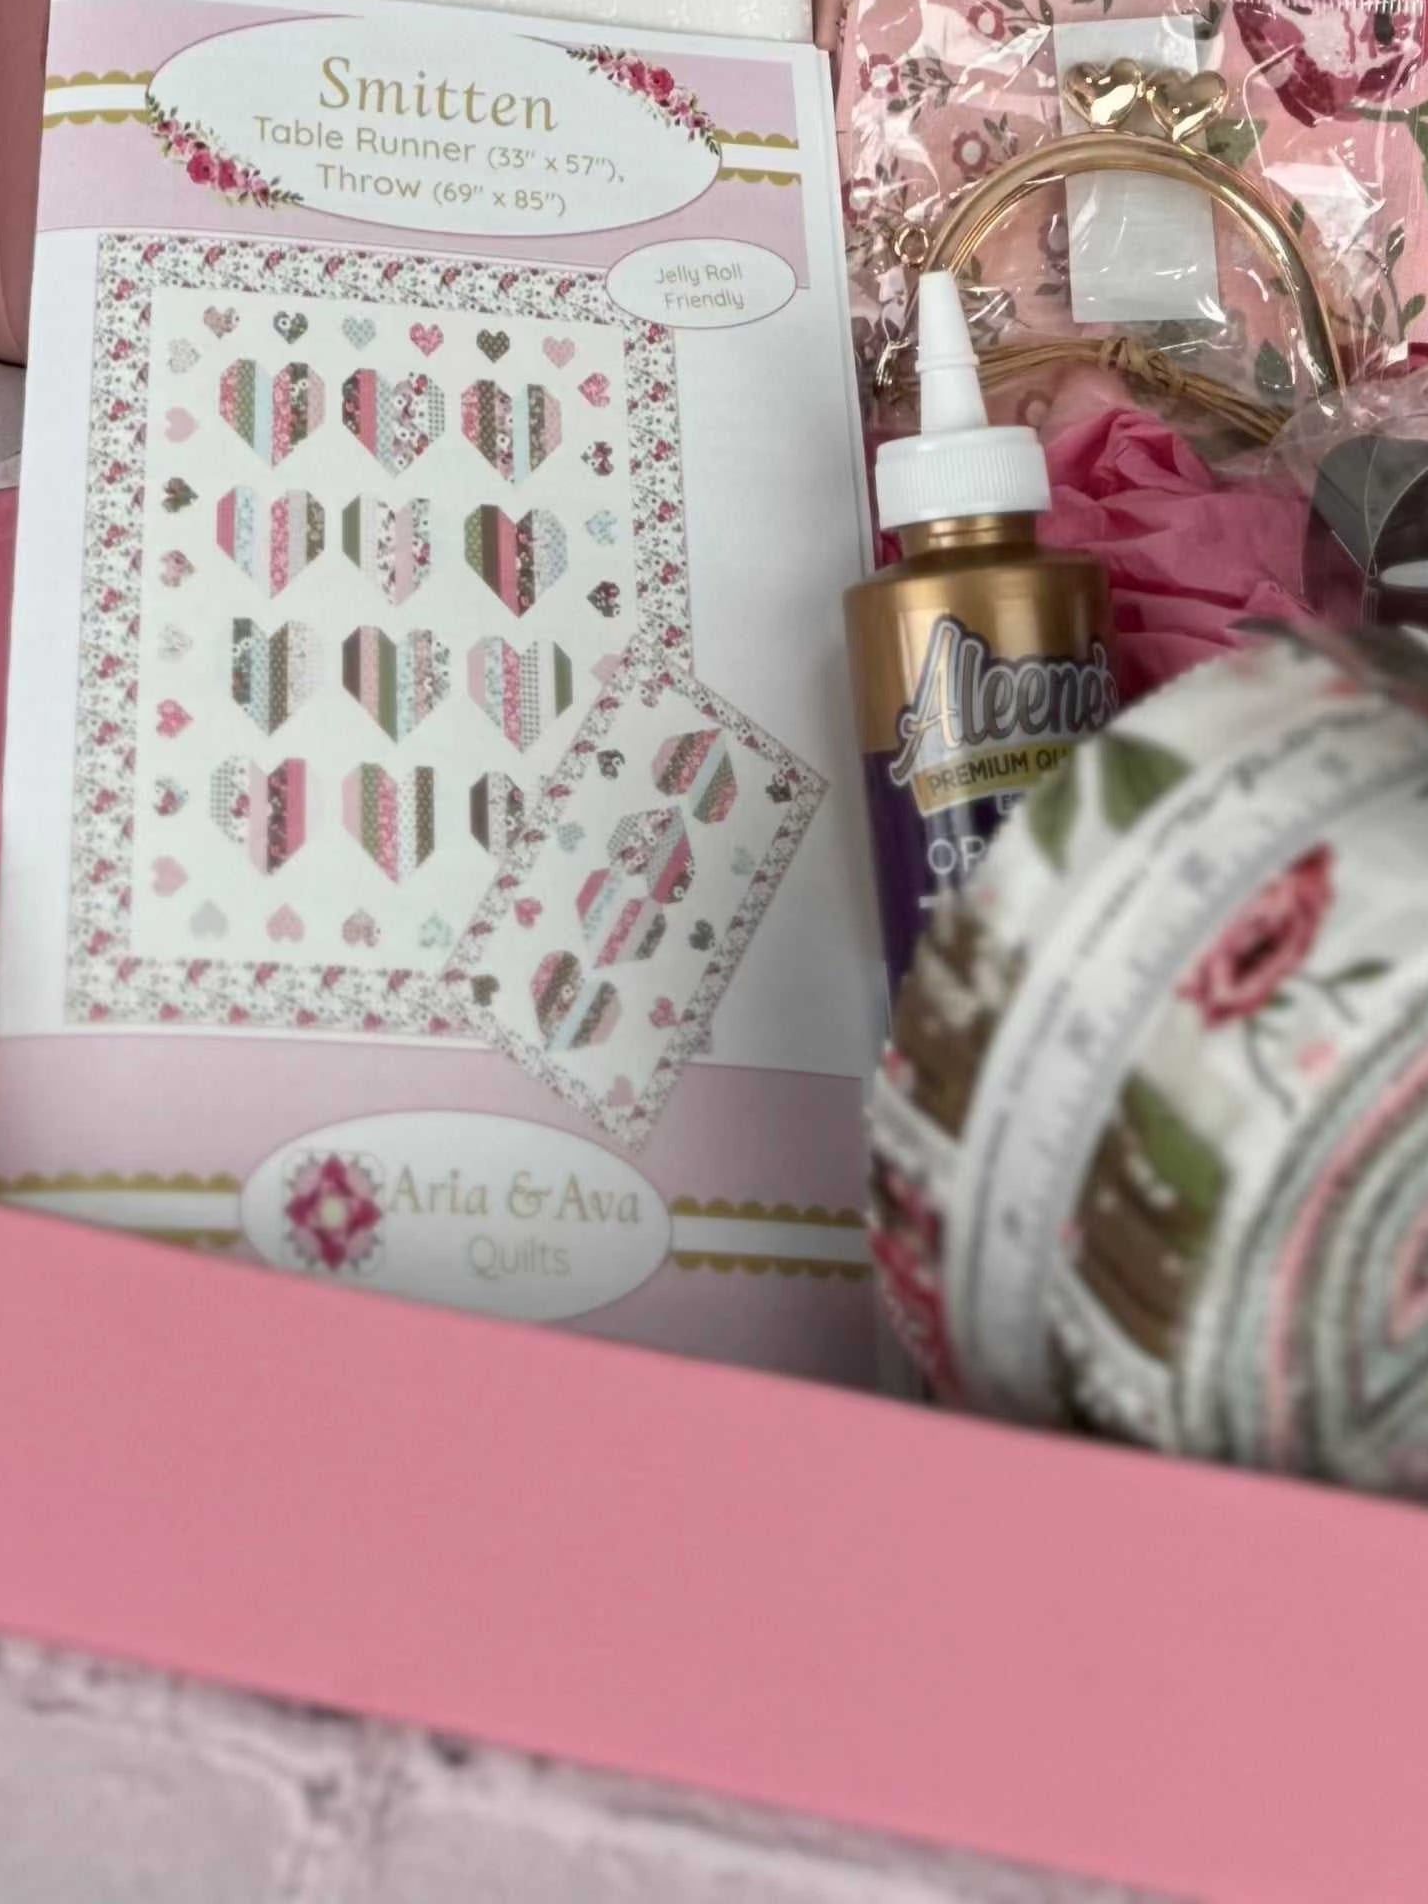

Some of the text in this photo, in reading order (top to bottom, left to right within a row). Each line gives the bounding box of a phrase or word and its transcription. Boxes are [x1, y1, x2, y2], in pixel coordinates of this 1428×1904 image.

[319, 54, 558, 133] Smitten
[253, 116, 344, 151] Table
[353, 126, 475, 164] Runner
[545, 155, 557, 171] x
[316, 163, 420, 198] Throw
[493, 192, 506, 208] x
[654, 262, 743, 288] Jelly Roll
[663, 290, 745, 312] Friendly
[889, 616, 1119, 785] Aleene's
[929, 750, 1028, 794] PREMIUM
[387, 1164, 641, 1224] Aria & Ava
[467, 1233, 570, 1278] Quilts
